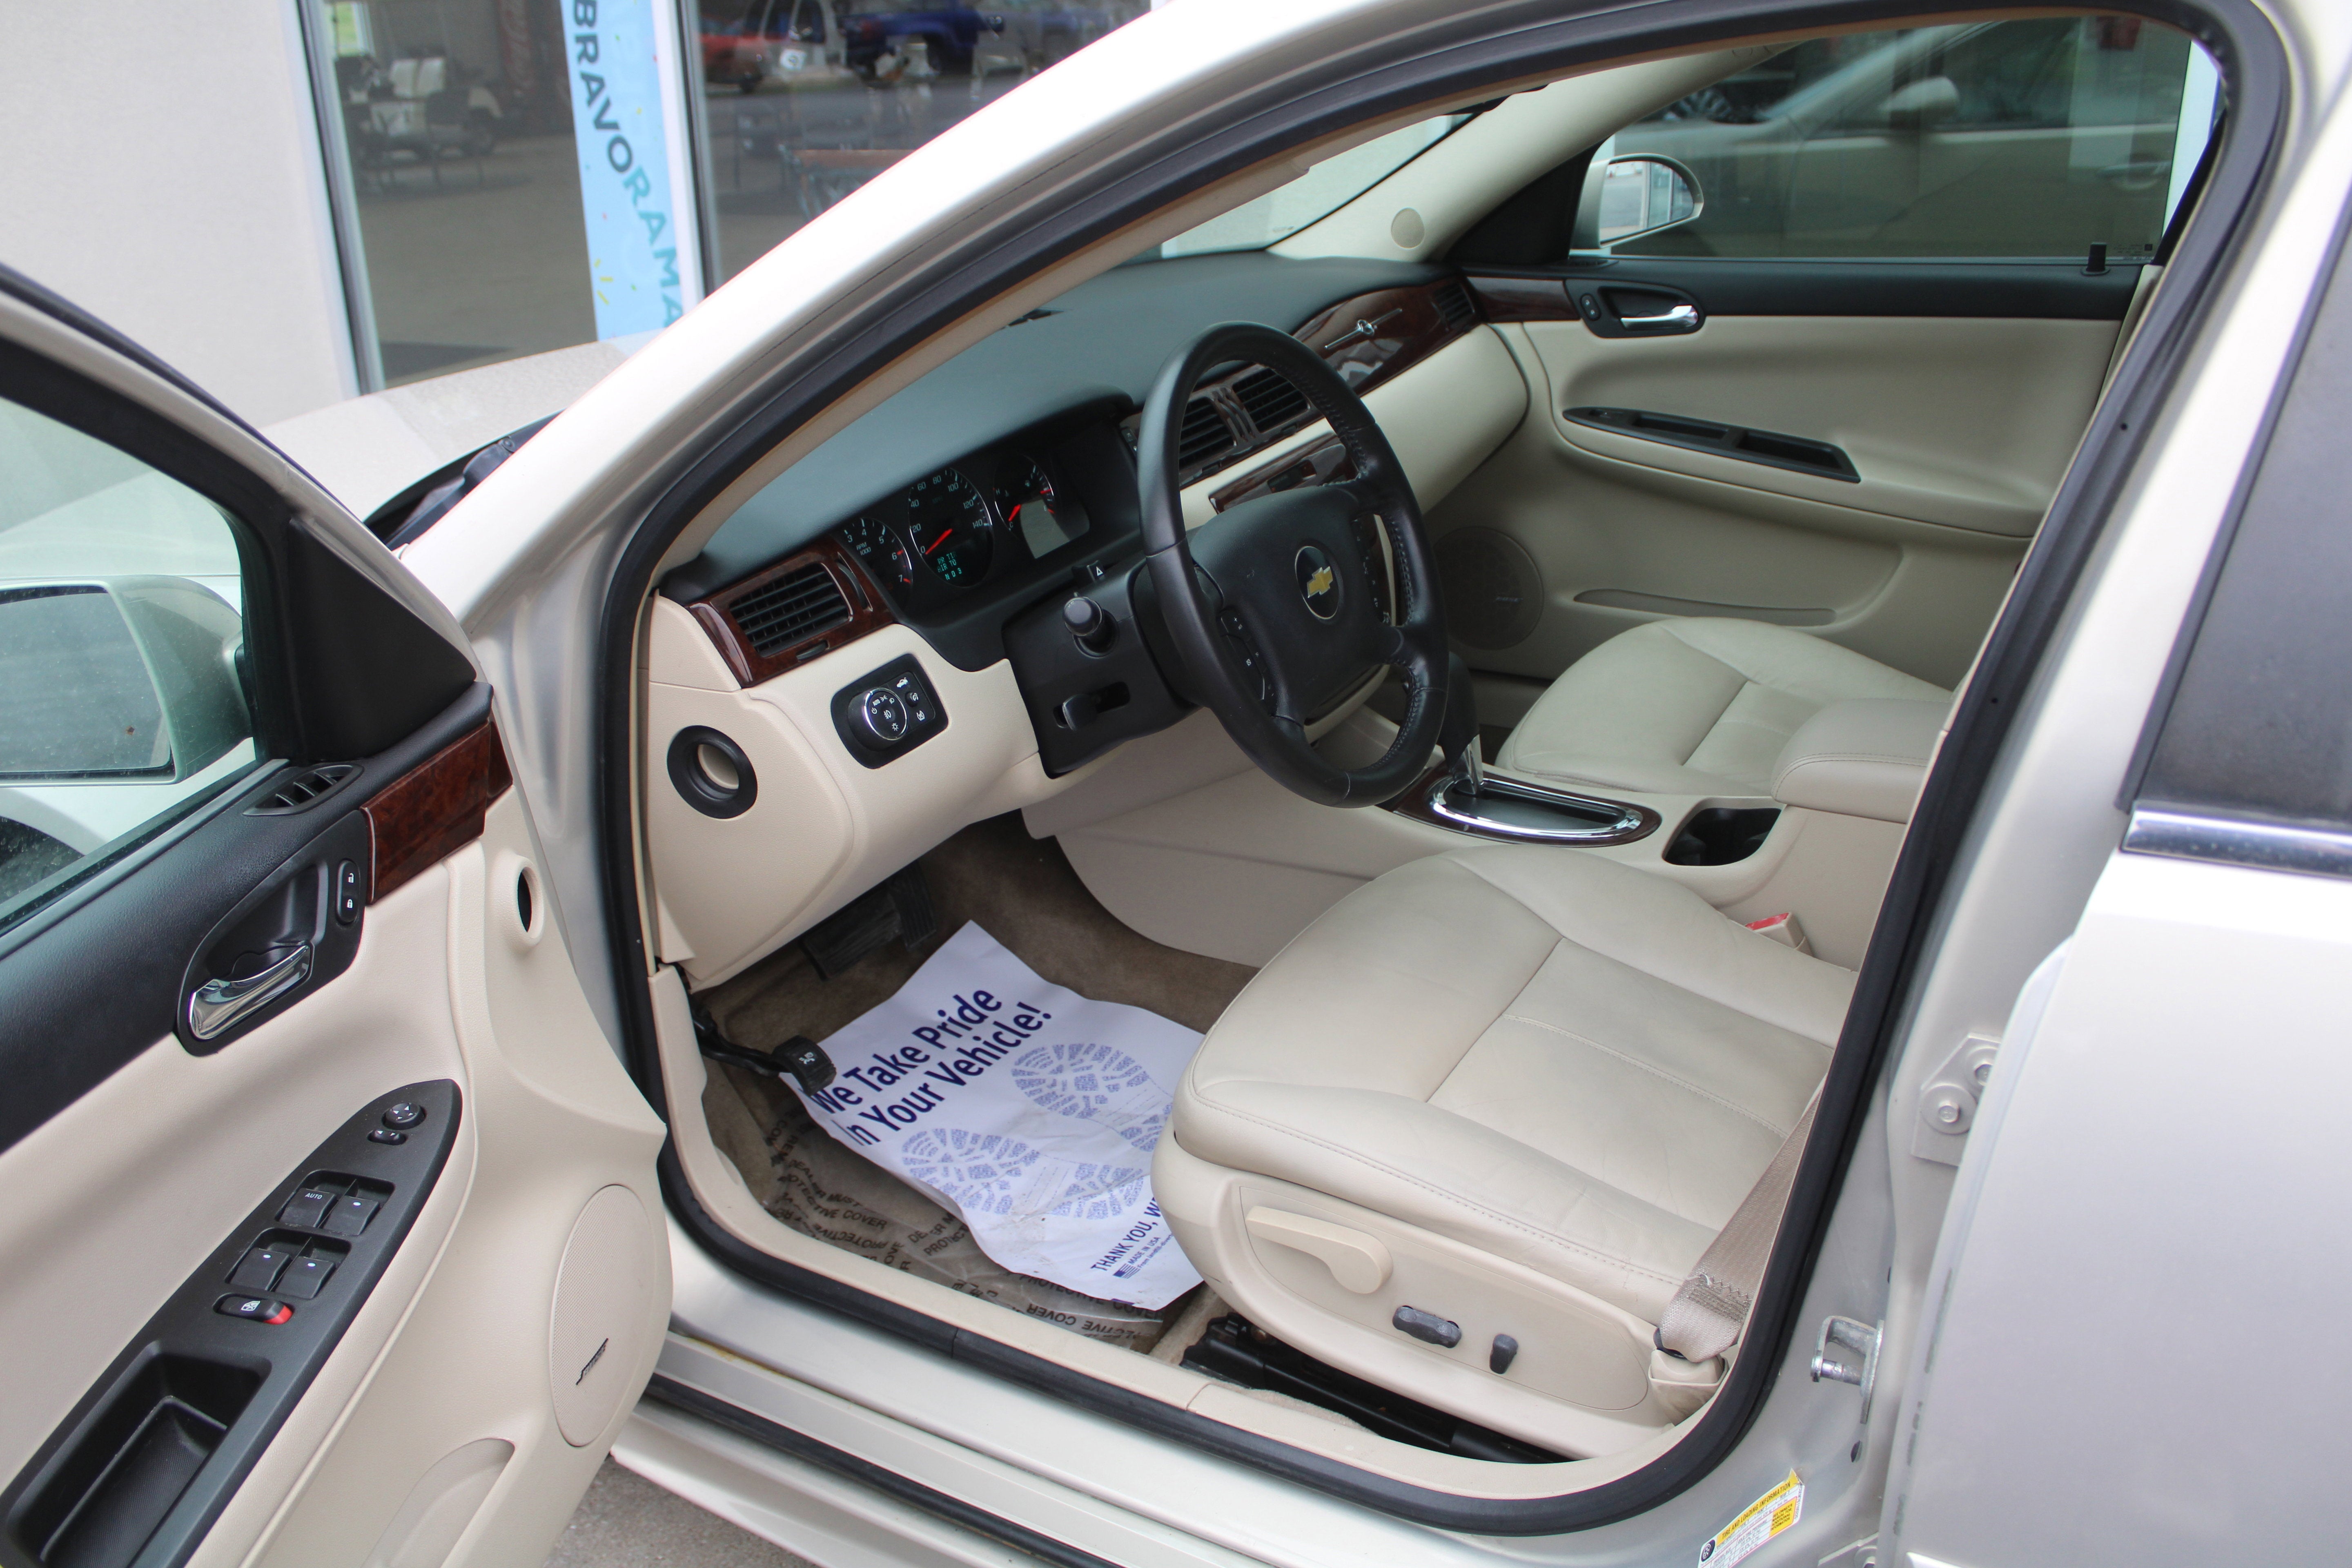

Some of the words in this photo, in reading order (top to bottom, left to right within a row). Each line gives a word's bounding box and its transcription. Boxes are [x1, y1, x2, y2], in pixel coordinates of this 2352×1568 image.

[933, 475, 941, 484] 80
[917, 482, 926, 490] 60
[948, 482, 959, 492] 100
[911, 499, 919, 508] 40
[963, 499, 974, 509] 120
[912, 523, 921, 533] 20
[972, 519, 982, 529] 140
[856, 542, 867, 550] RPM
[860, 547, 871, 555] 1000
[798, 1086, 863, 1114] We
[842, 1046, 930, 1092] Take
[911, 990, 1002, 1050] Pride
[858, 1082, 945, 1131] Your
[923, 1001, 1052, 1087] Vehicle!
[826, 1193, 863, 1207] MUST
[842, 1209, 888, 1230] COVER
[1090, 1243, 1134, 1272] THANK
[1122, 1221, 1158, 1243] YOU,
[1144, 1196, 1162, 1218] W
[1127, 1251, 1145, 1265] MADE
[1147, 1237, 1161, 1246] USA
[1025, 1303, 1077, 1326] COVER
[1722, 1528, 1731, 1539] TIRE
[1731, 1519, 1740, 1530] AND
[1740, 1503, 1759, 1523] LOADING
[1759, 1481, 1791, 1509] INFORMATION
